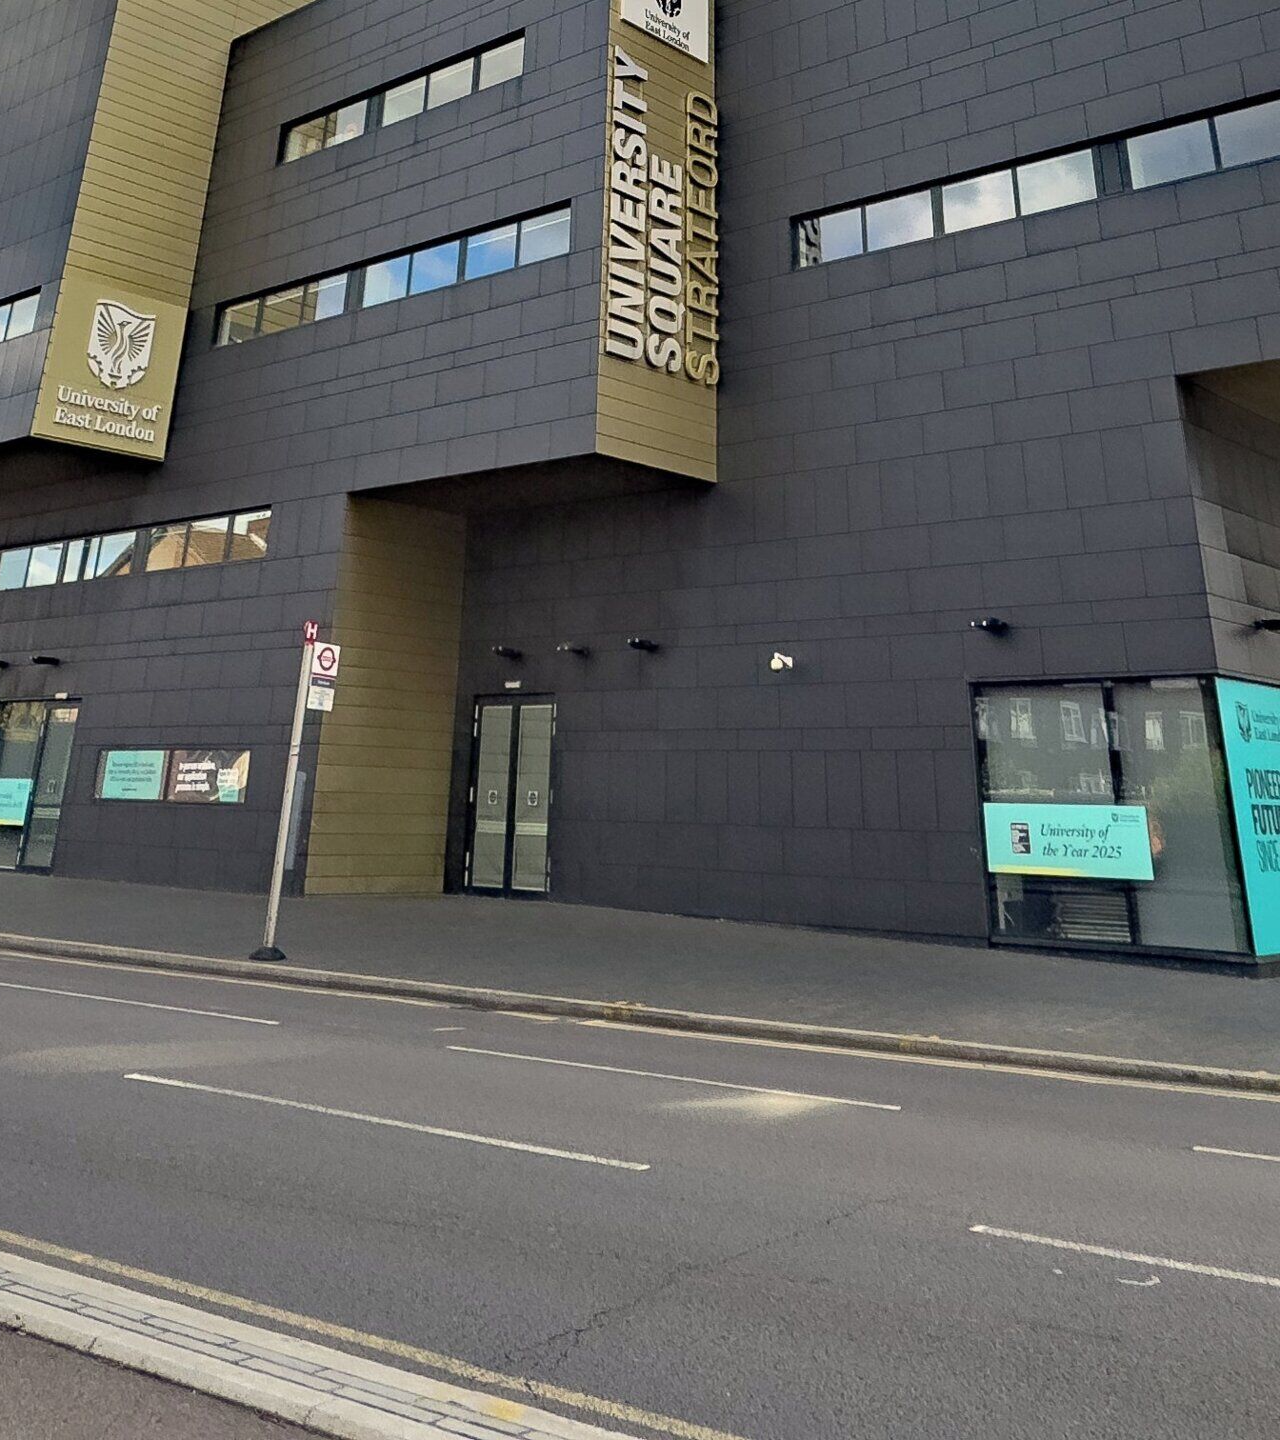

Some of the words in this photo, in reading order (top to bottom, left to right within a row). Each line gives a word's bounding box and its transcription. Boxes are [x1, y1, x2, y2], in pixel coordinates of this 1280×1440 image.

[645, 8, 681, 37] University
[682, 31, 690, 41] of
[645, 21, 661, 36] East
[663, 30, 690, 52] London
[605, 45, 648, 361] UNIVERSITY
[685, 91, 719, 385] STRATFORD
[646, 154, 685, 374] SQUARE
[57, 385, 140, 420] University
[142, 405, 161, 421] of
[53, 406, 92, 429] East
[94, 415, 155, 442] London
[306, 622, 318, 639] H
[1040, 823, 1096, 842] University
[1098, 824, 1111, 844] of
[1042, 842, 1059, 857] the
[1063, 844, 1089, 858] Year
[1091, 845, 1122, 859] 2025
[1257, 840, 1280, 872] SINCE
